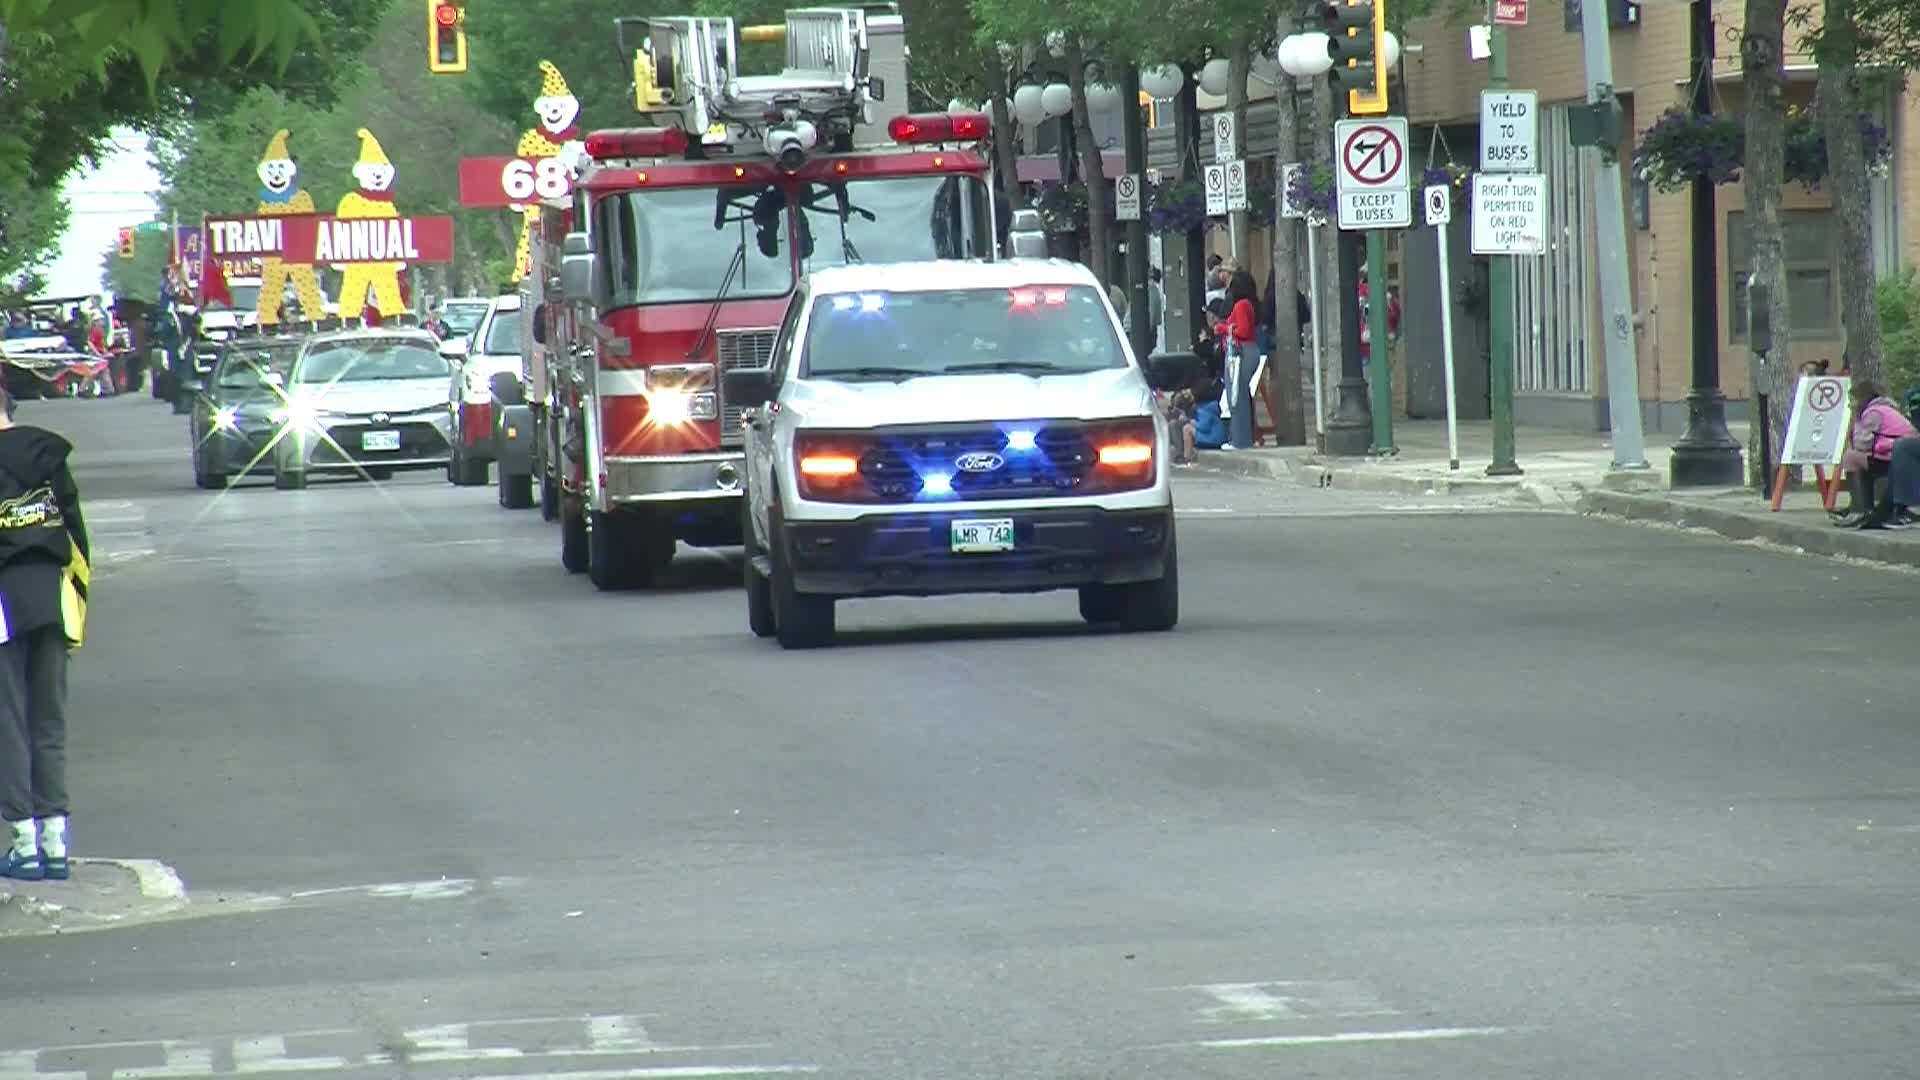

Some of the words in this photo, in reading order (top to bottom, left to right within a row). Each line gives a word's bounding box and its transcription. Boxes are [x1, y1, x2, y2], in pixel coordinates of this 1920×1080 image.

[1490, 103, 1527, 118] YIELD
[1500, 124, 1514, 139] TO
[1488, 145, 1528, 160] BUSES
[502, 158, 569, 199] 68
[1482, 185, 1508, 197] RIGHT
[1512, 184, 1537, 196] TURN
[1352, 194, 1396, 208] EXCEPT
[1484, 200, 1534, 212] PERMITTED
[1355, 207, 1394, 221] BUSES
[1490, 215, 1505, 228] ON
[1508, 215, 1526, 228] RED
[316, 219, 419, 260] ANNUAL
[1495, 231, 1521, 244] LIGHT
[963, 455, 997, 470] Ford
